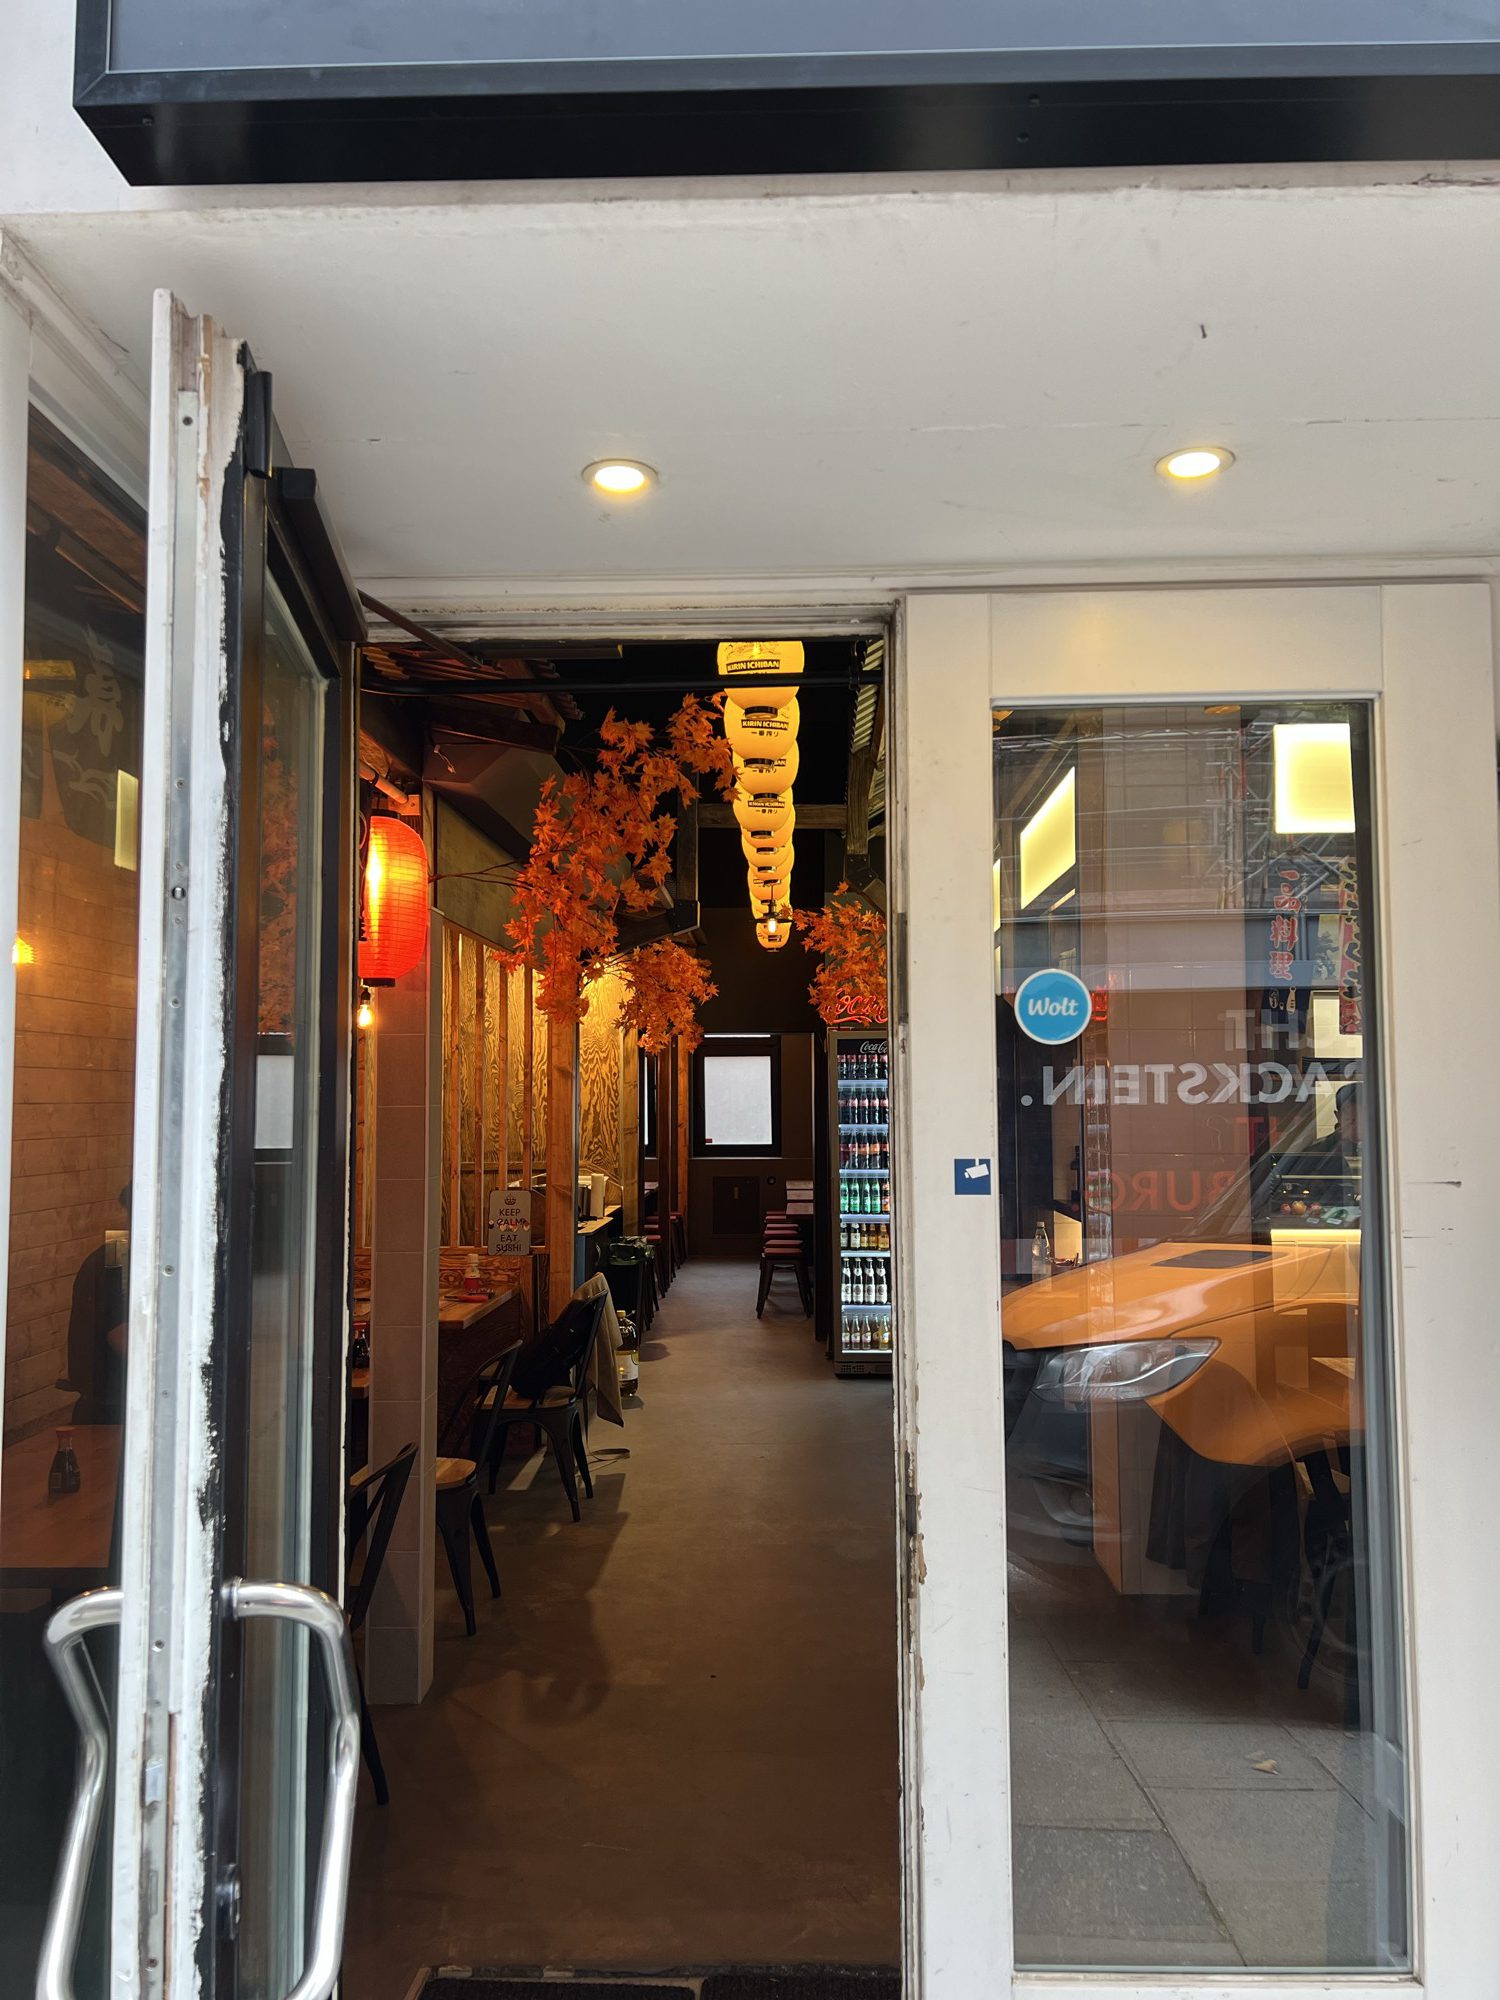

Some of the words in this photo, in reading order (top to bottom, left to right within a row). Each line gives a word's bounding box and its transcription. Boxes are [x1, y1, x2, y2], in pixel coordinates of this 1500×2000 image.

[727, 662, 747, 671] KIRIN
[747, 659, 780, 670] ICHIBAN
[742, 720, 762, 728] KIRIN
[763, 721, 788, 730] ICHIBAN
[1027, 998, 1079, 1018] Wolt
[499, 1208, 521, 1217] KEEP
[500, 1234, 518, 1243] EAT
[495, 1243, 522, 1253] SUSHI
